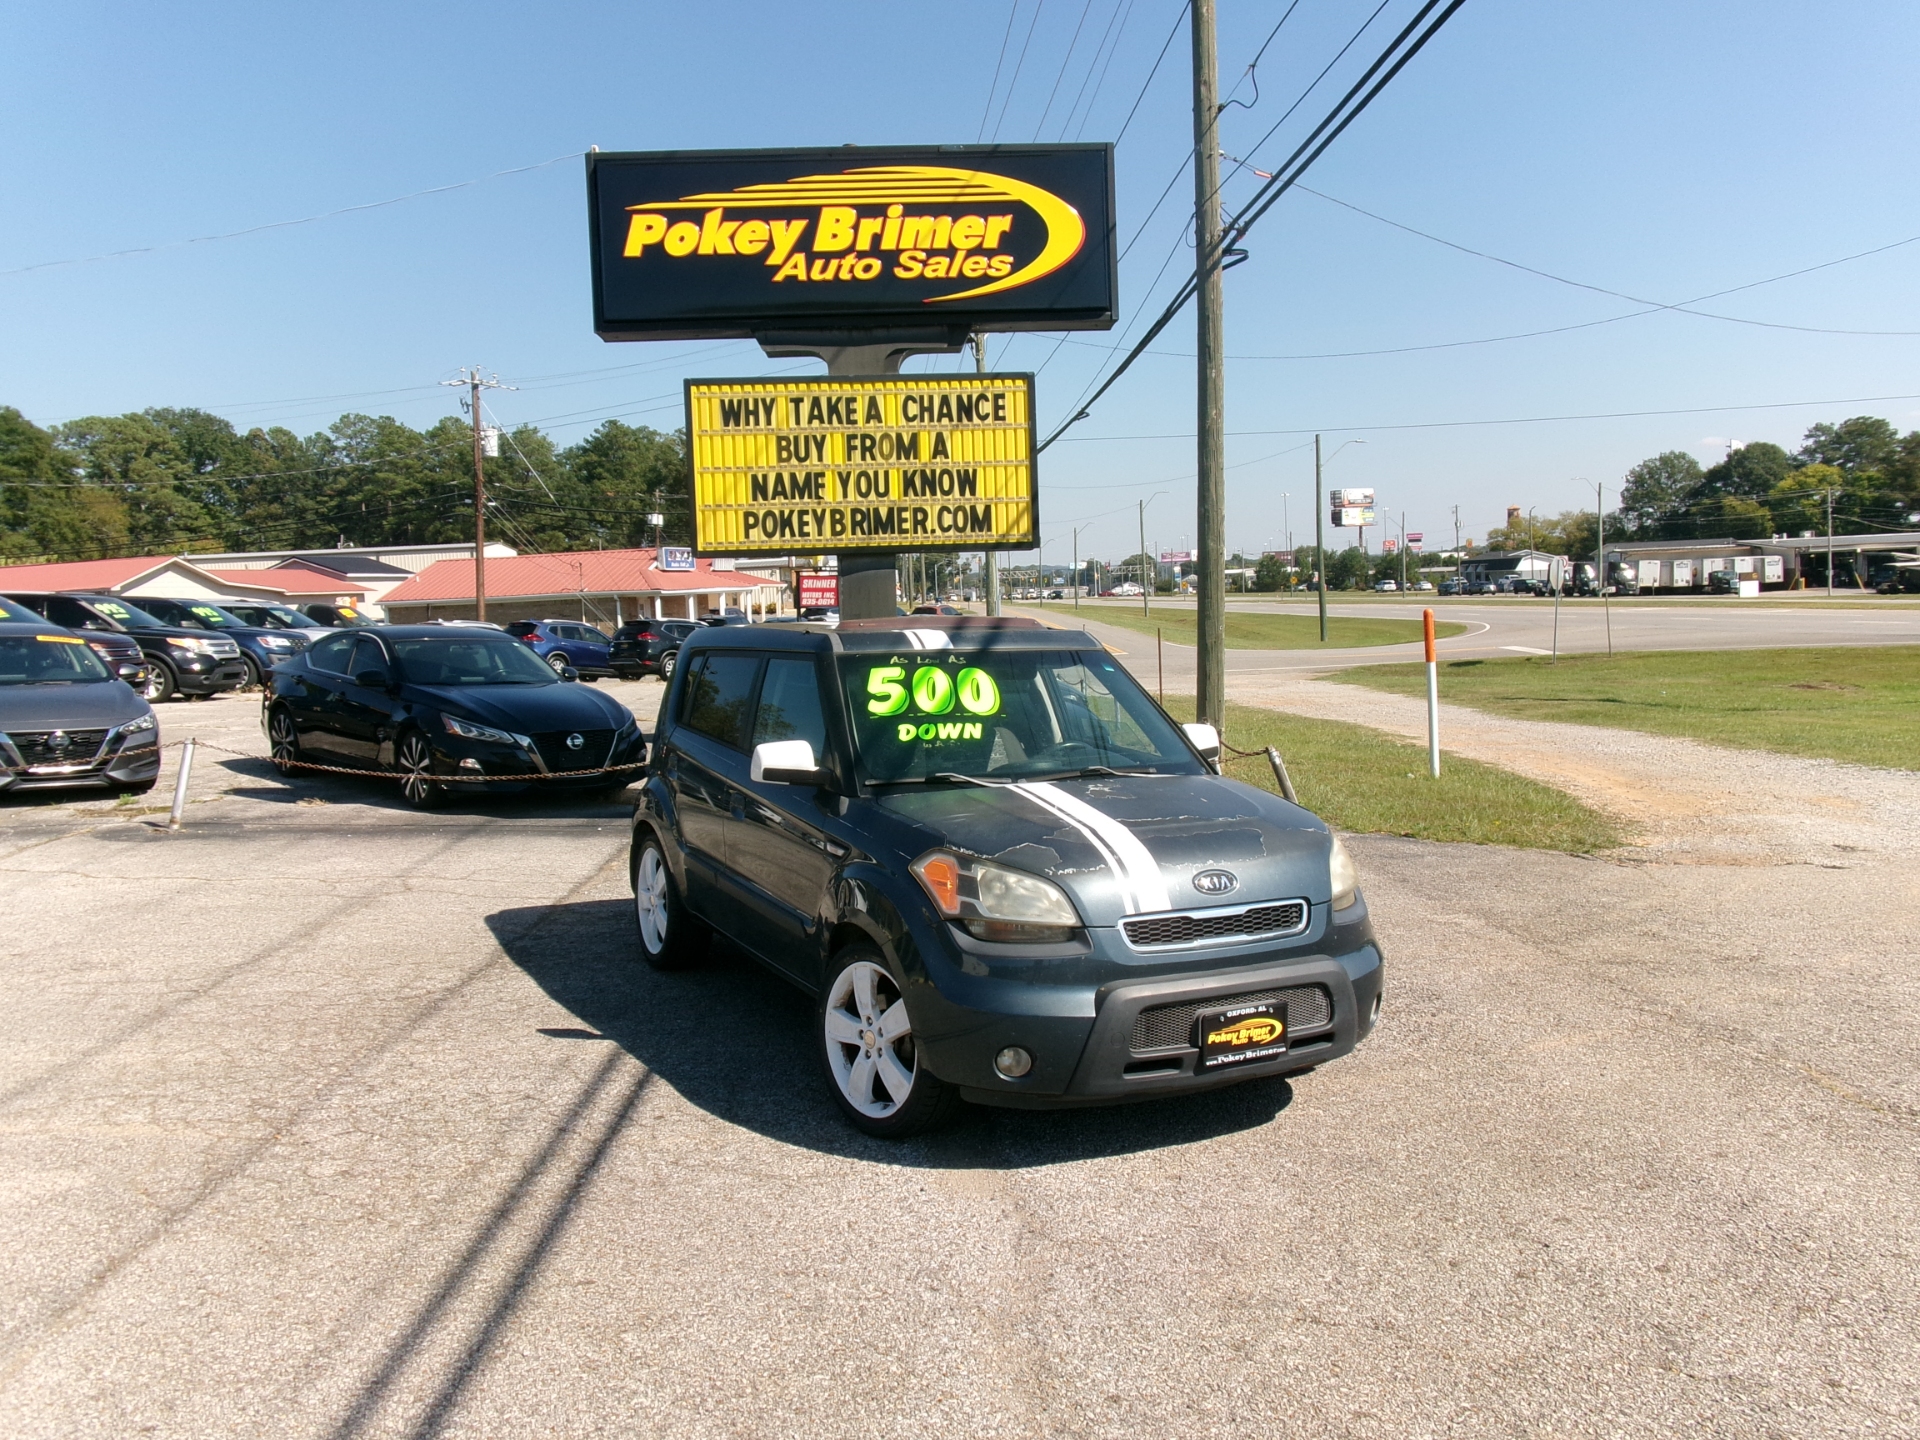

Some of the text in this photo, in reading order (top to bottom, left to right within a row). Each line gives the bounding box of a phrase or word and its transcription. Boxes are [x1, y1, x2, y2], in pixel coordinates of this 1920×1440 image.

[623, 204, 1013, 265] Pokey Brimer
[772, 249, 1014, 282] Auto Sales
[719, 393, 1006, 427] WHY TAKE A CHANCE
[776, 431, 950, 463] BUY FROM A
[751, 468, 978, 501] NAME YOU KNOW
[743, 504, 992, 539] POKEYBRIMER.COM
[802, 579, 836, 588] SKINNER
[867, 666, 1000, 716] 500
[897, 722, 982, 741] DOWN
[1207, 1026, 1271, 1045] Pokey Brimer
